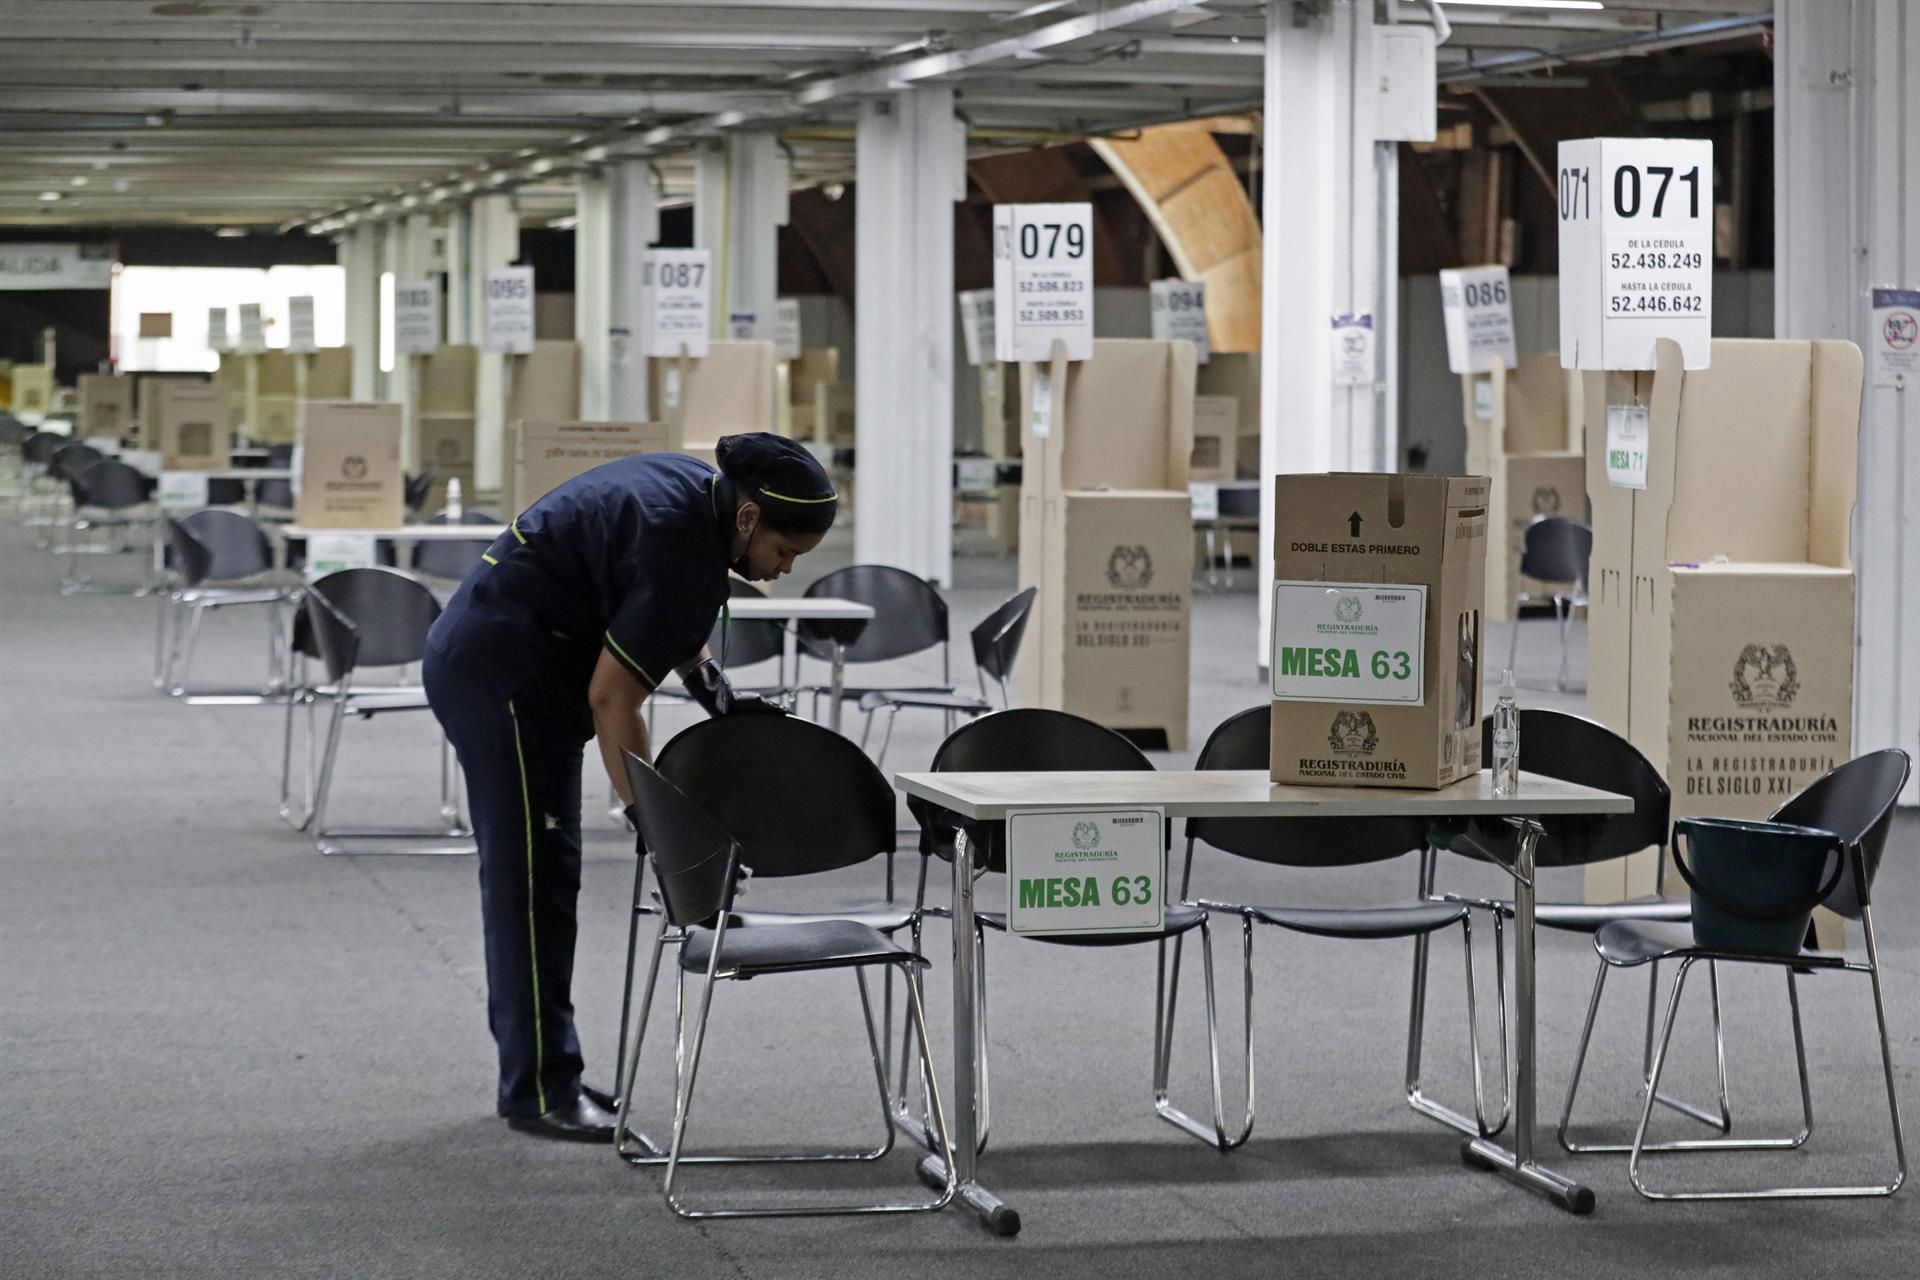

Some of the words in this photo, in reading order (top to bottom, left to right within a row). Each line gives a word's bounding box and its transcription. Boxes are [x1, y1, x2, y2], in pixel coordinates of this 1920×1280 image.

[1560, 166, 1590, 221] 071
[1613, 164, 1699, 219] 071
[1020, 223, 1085, 260] 079
[1628, 239, 1639, 249] DE
[1641, 239, 1651, 249] LA
[1611, 253, 1702, 269] 52.438.249
[659, 263, 705, 288] 087
[1465, 280, 1507, 308] 086
[1621, 282, 1647, 291] HASTA
[1648, 282, 1659, 291] LA
[1611, 296, 1702, 312] 52.446.642
[1291, 542, 1329, 553] DOBLE
[1331, 543, 1366, 554] ESTAS
[1368, 544, 1420, 556] PRIMERO
[1281, 647, 1361, 678] MESA
[1371, 650, 1412, 680] 63
[1687, 713, 1838, 732] REGISTRADURÍA
[1687, 733, 1739, 743] NACIONAL
[1743, 733, 1763, 743] DEL
[1767, 733, 1808, 743] ESTADO
[1811, 733, 1838, 743] CIVIL
[1299, 758, 1407, 773] REGISTRADURÍA
[1687, 757, 1703, 772] LA
[1712, 754, 1835, 772] REGISTRADURÍA
[1299, 769, 1337, 778] NACIONAL
[1355, 771, 1385, 779] ESTADO
[1386, 772, 1407, 780] CIVIL
[1687, 777, 1713, 795] DEL
[1716, 777, 1761, 795] SIGLO
[1767, 777, 1792, 795] XXI
[1055, 848, 1118, 859] REGISTRADURÍA
[1019, 876, 1101, 909] MESA
[1111, 875, 1152, 906] 63
